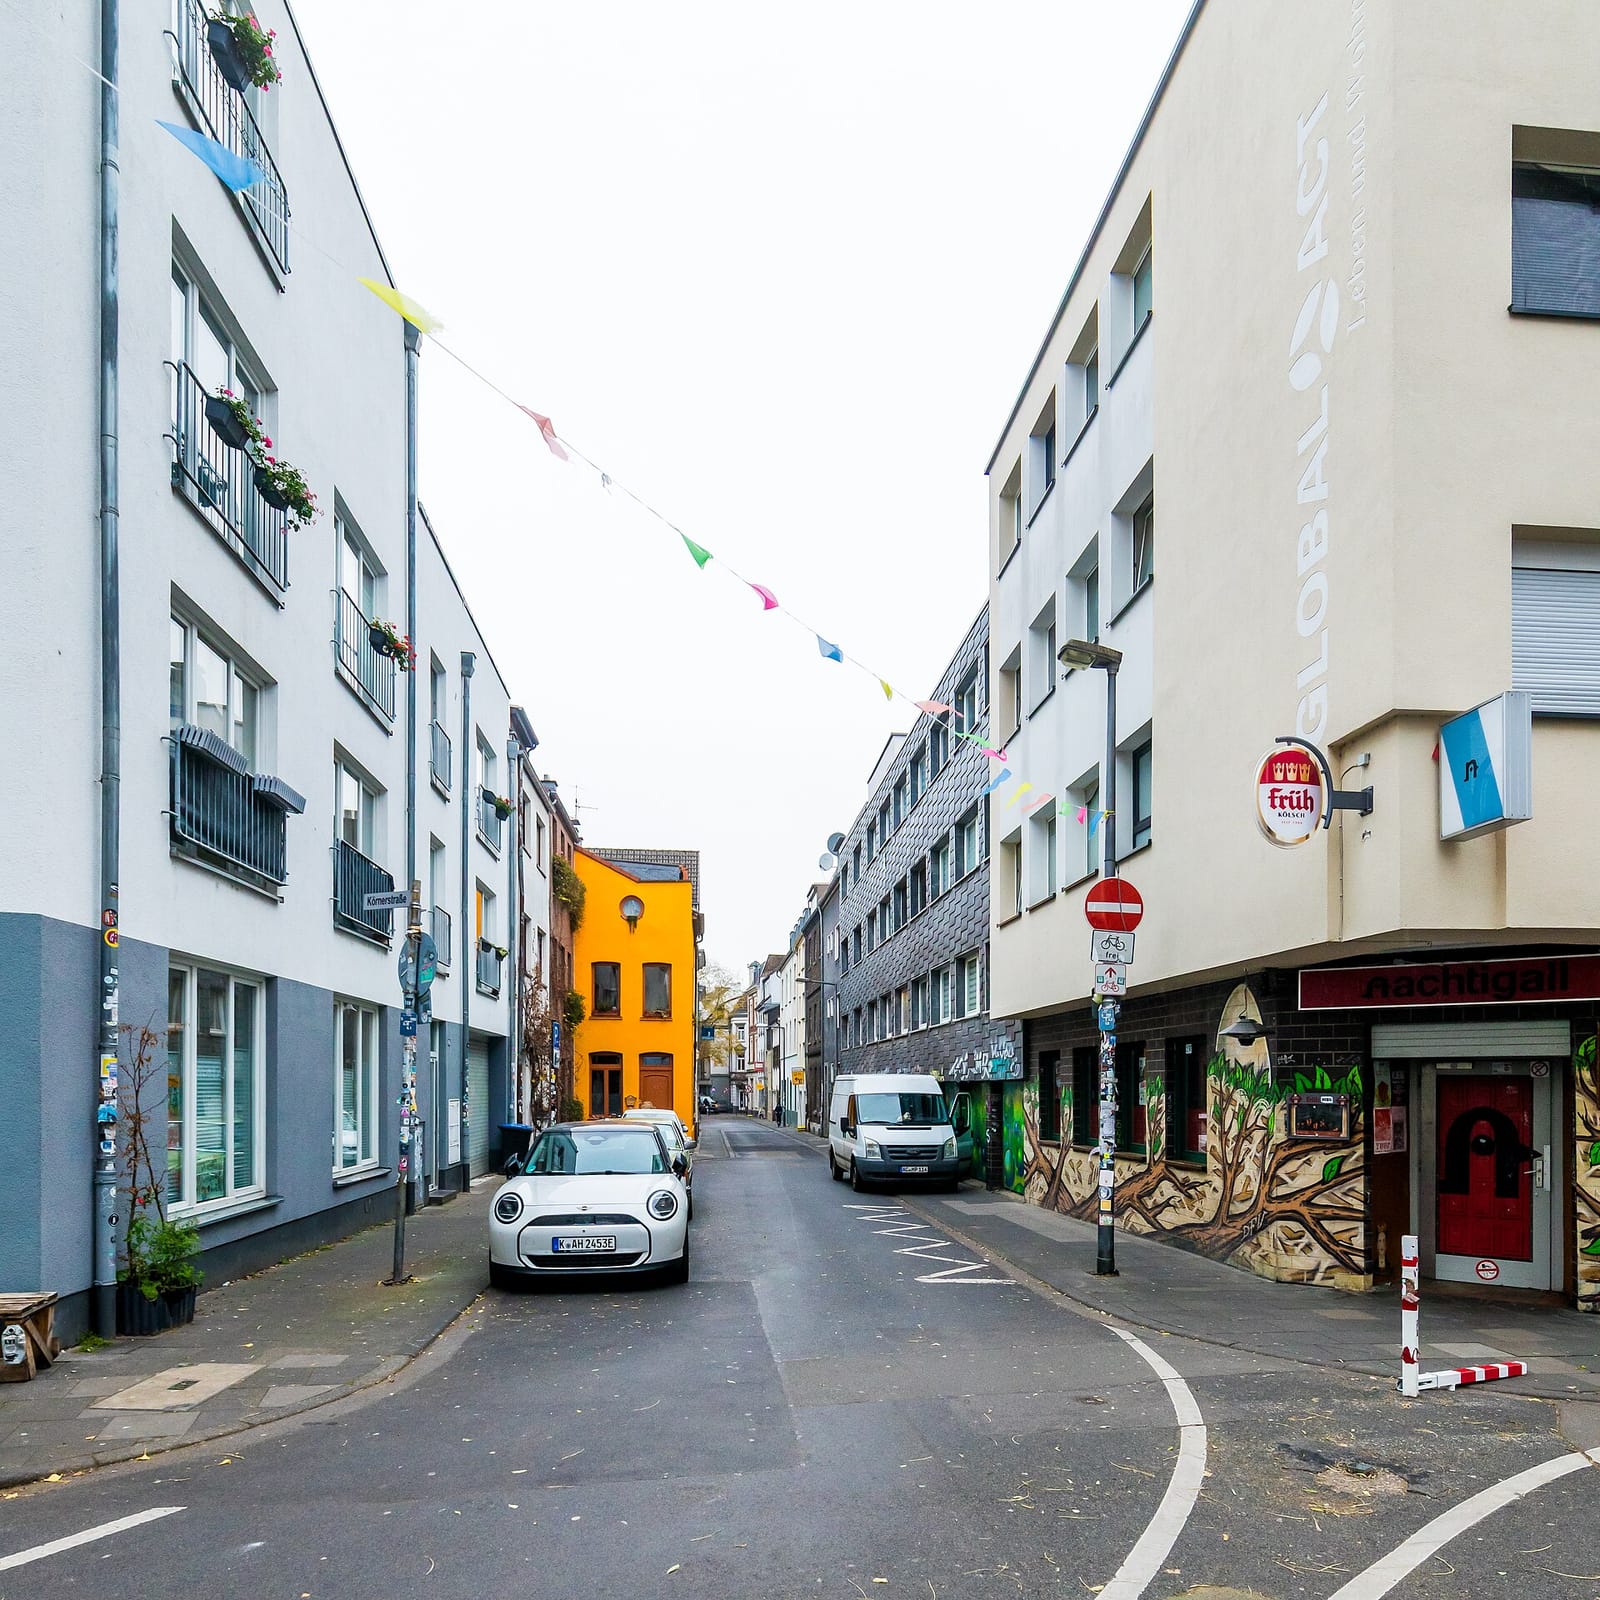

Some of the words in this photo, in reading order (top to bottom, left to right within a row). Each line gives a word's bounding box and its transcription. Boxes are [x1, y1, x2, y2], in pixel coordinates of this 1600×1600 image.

[1346, 115, 1367, 198] und
[1346, 206, 1367, 333] Leben
[1296, 383, 1329, 746] GLOBAL
[367, 893, 407, 906] Körnerstraße
[1105, 951, 1118, 959] frei
[559, 1239, 565, 1248] K
[572, 1239, 583, 1248] AH
[585, 1238, 613, 1248] 2453E
